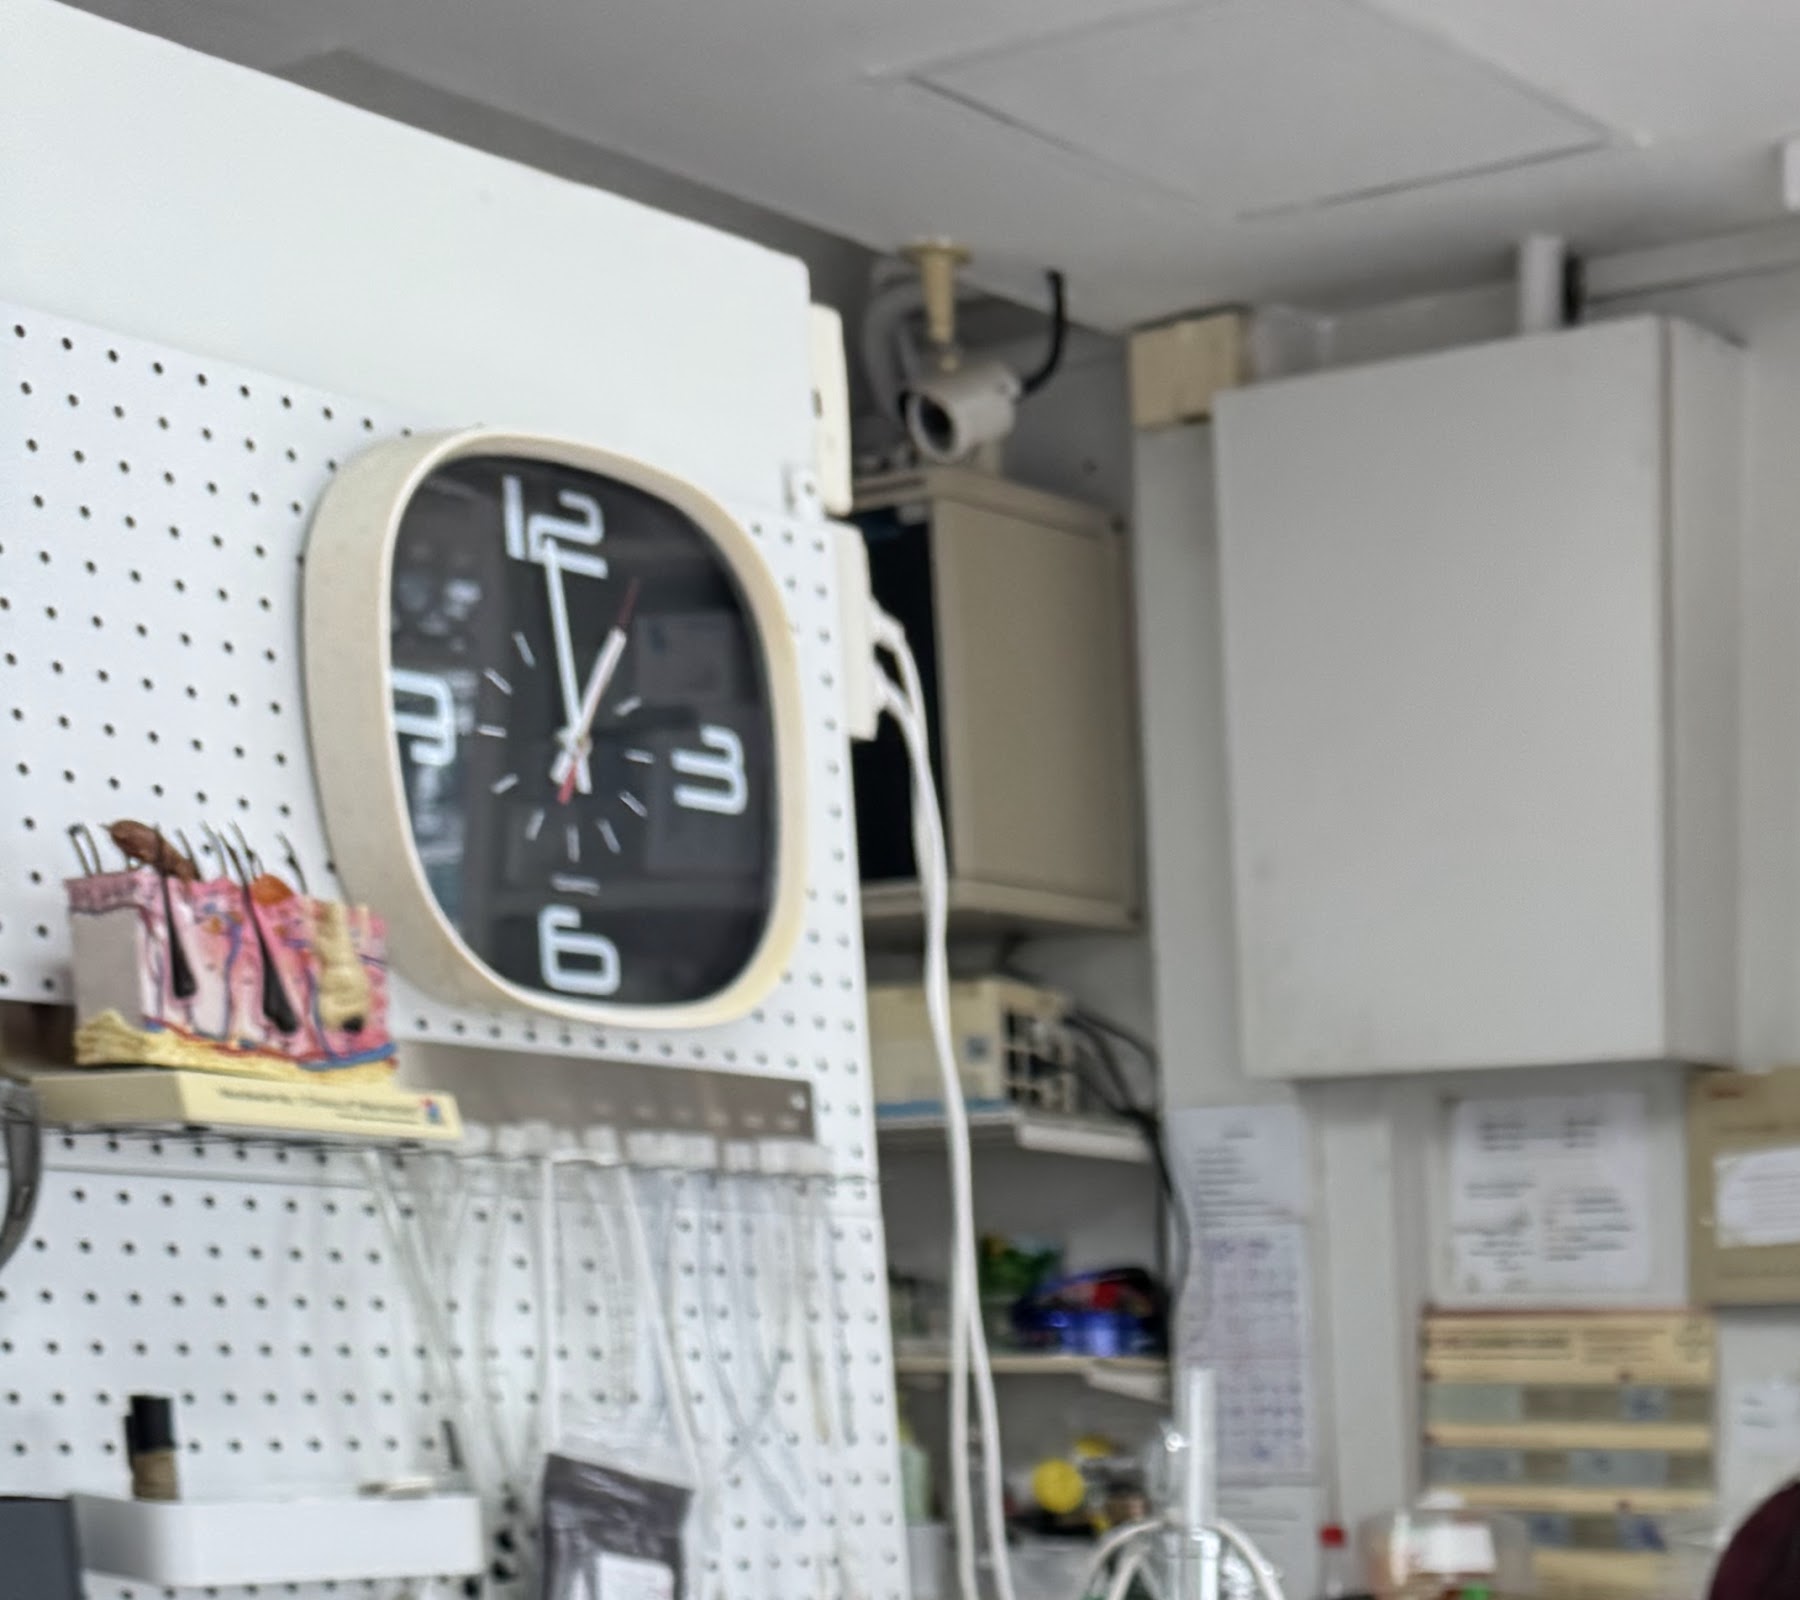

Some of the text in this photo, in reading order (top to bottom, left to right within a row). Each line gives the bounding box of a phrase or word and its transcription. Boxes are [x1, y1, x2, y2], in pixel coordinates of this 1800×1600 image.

[502, 475, 608, 579] 12
[390, 666, 457, 767] 9
[671, 725, 748, 816] 3
[537, 904, 621, 996] 6
